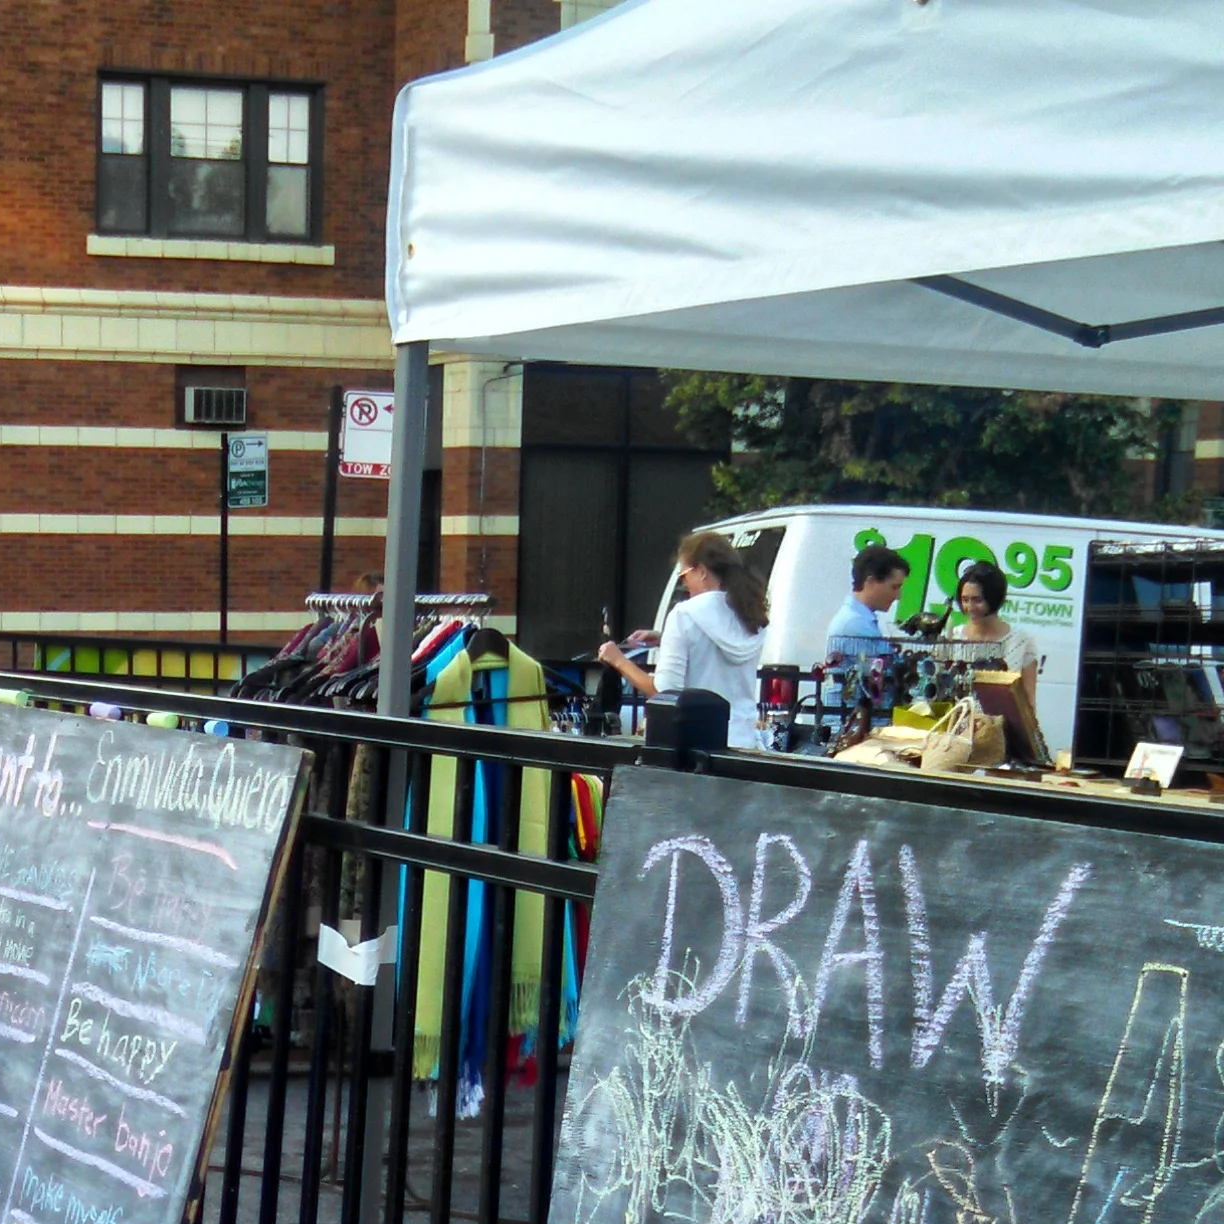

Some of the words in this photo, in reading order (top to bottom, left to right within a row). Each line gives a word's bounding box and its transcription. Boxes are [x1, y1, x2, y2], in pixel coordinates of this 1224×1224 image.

[346, 462, 374, 475] TOW
[379, 463, 391, 476] Z
[635, 831, 1094, 1100] DRAW
[60, 997, 95, 1045] Be
[96, 1008, 179, 1085] happy
[43, 1077, 108, 1138] Master
